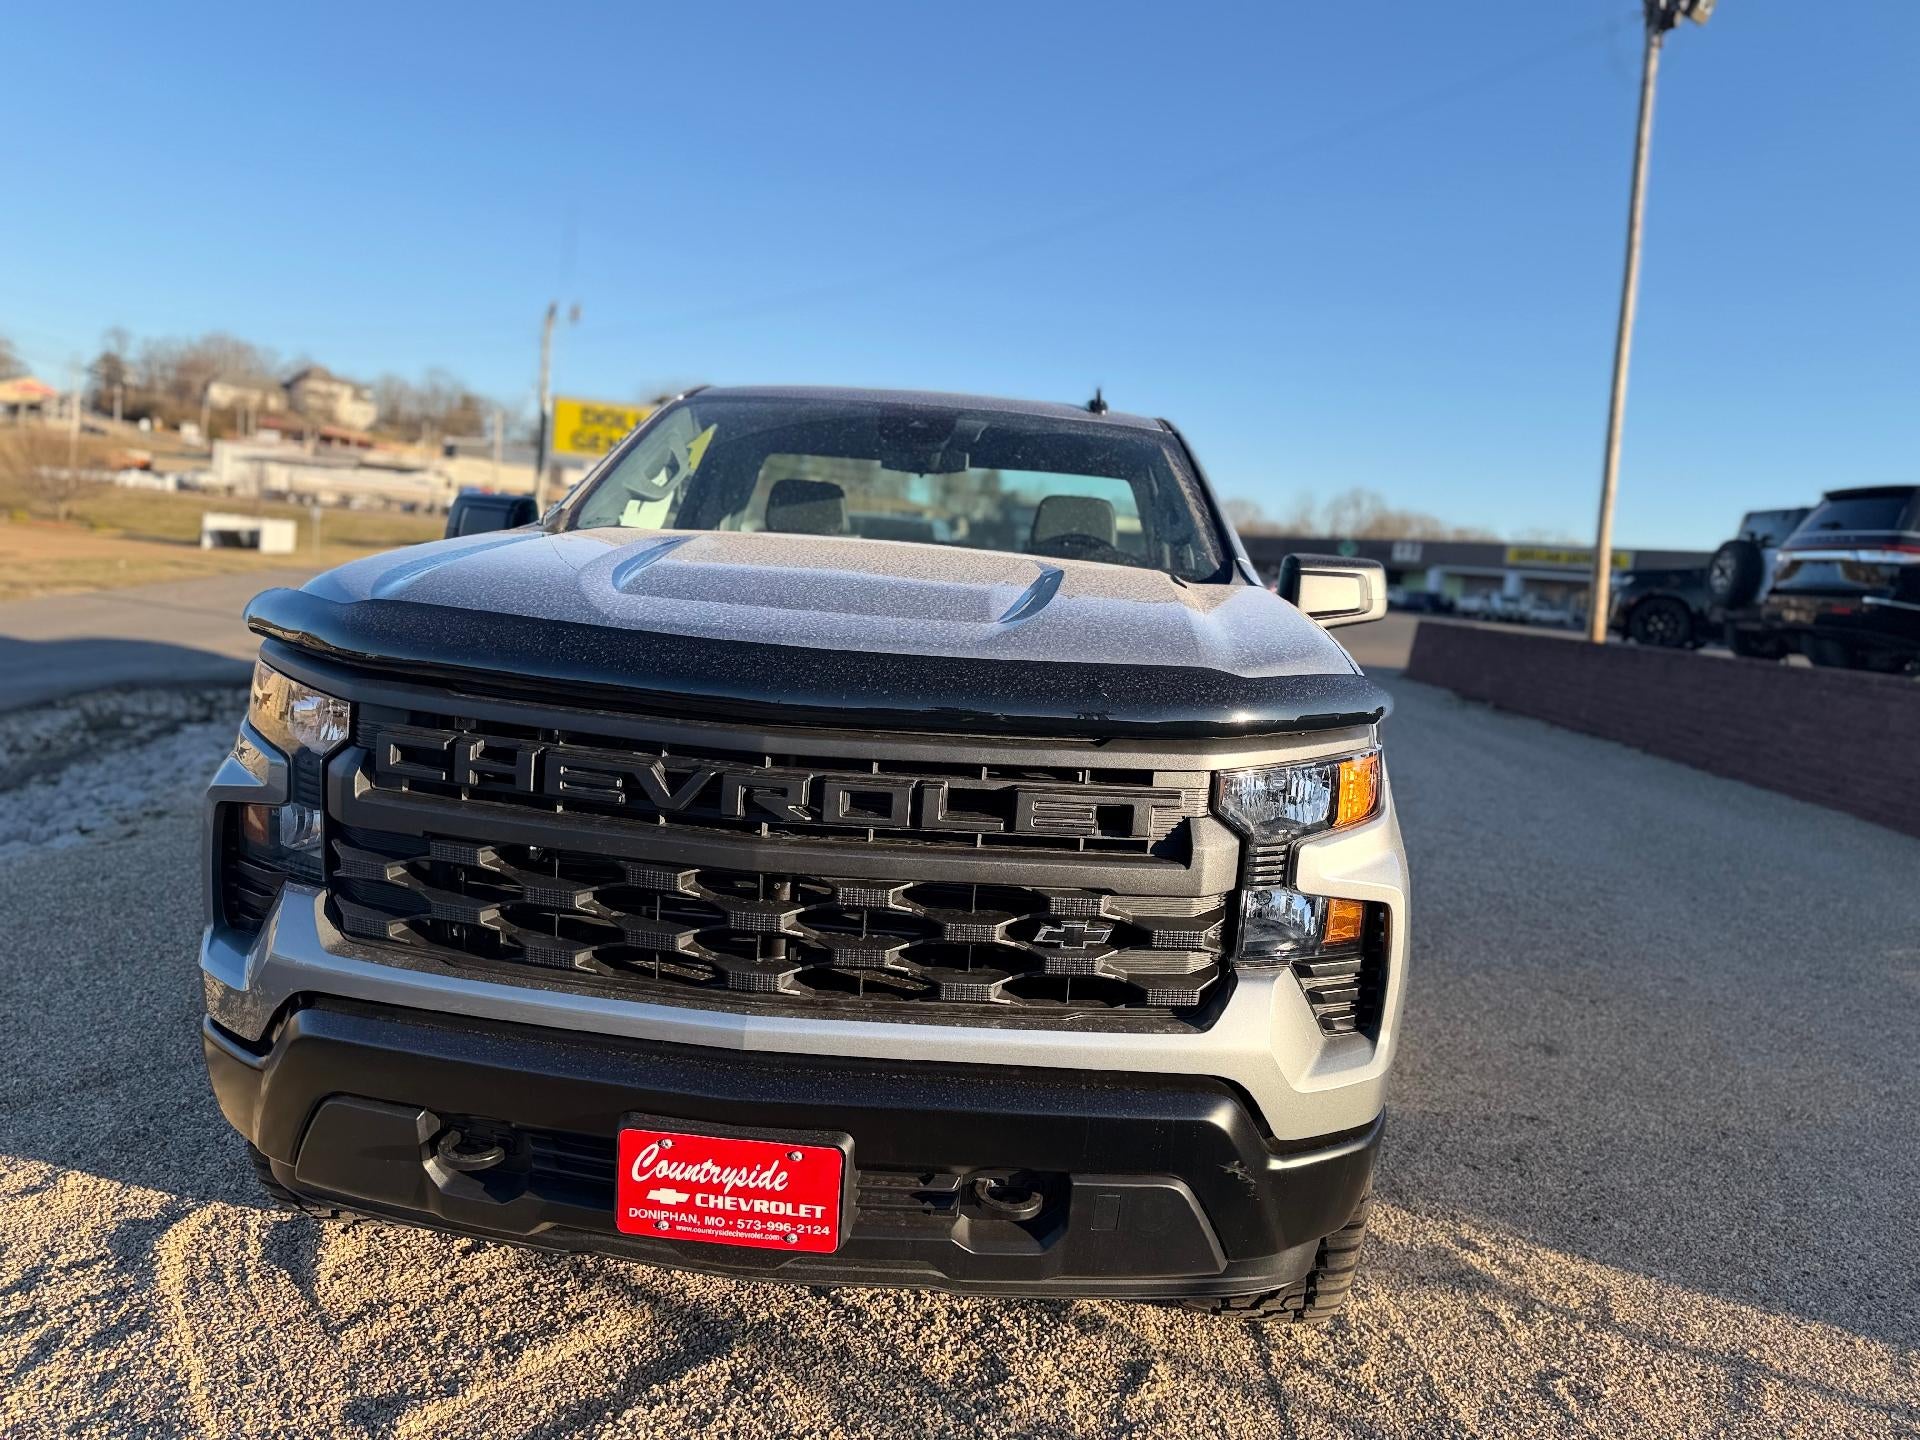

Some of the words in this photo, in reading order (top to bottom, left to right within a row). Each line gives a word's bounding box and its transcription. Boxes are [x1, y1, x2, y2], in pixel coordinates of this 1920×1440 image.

[375, 729, 1184, 837] CHEVROLET
[631, 1143, 789, 1194] Countryside
[694, 1192, 827, 1219] CHEVROLET
[628, 1207, 701, 1227] DONIPHAN,
[704, 1215, 726, 1228] MO
[736, 1219, 831, 1236] 573-996-2124
[675, 1223, 780, 1241] www.countrysidechevrolet.com
